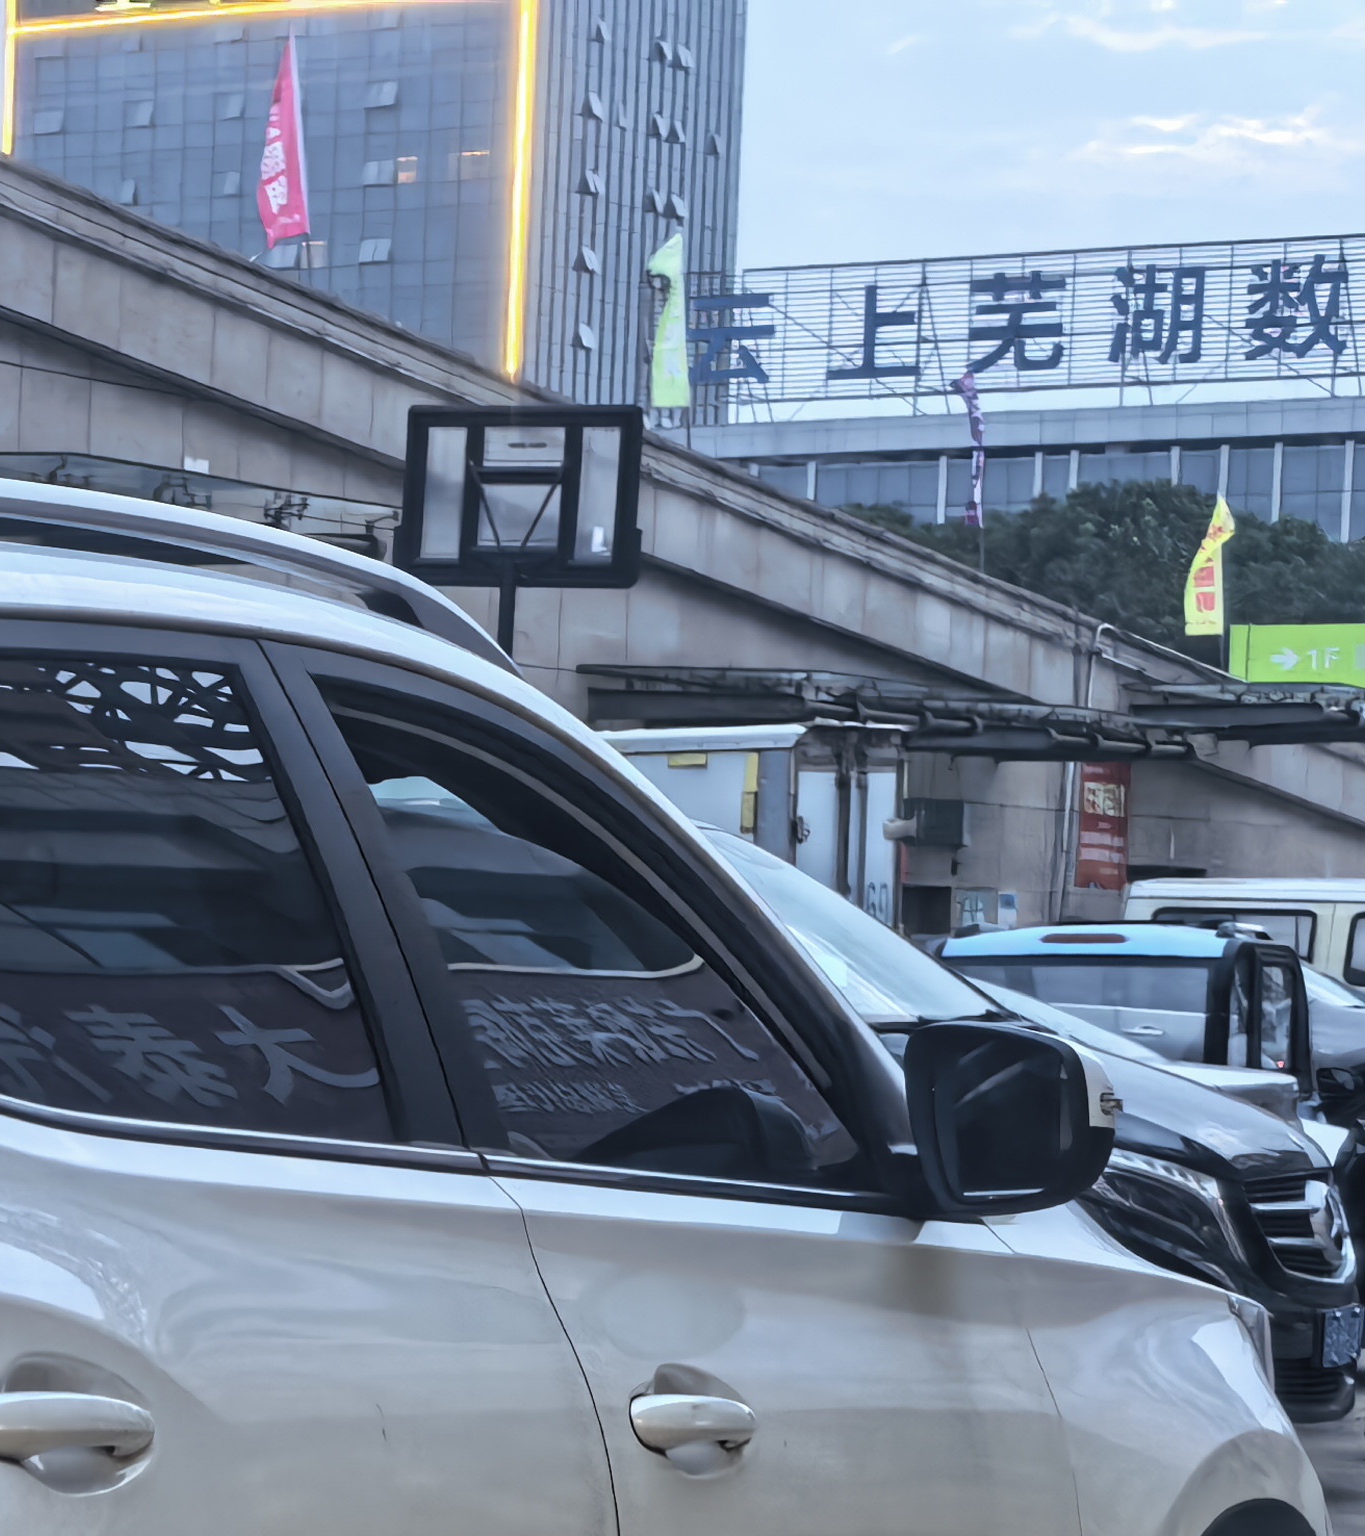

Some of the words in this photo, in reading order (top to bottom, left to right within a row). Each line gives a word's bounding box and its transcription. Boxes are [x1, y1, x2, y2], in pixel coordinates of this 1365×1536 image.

[688, 252, 1349, 384] 云上芜湖数
[1307, 647, 1340, 671] 1F
